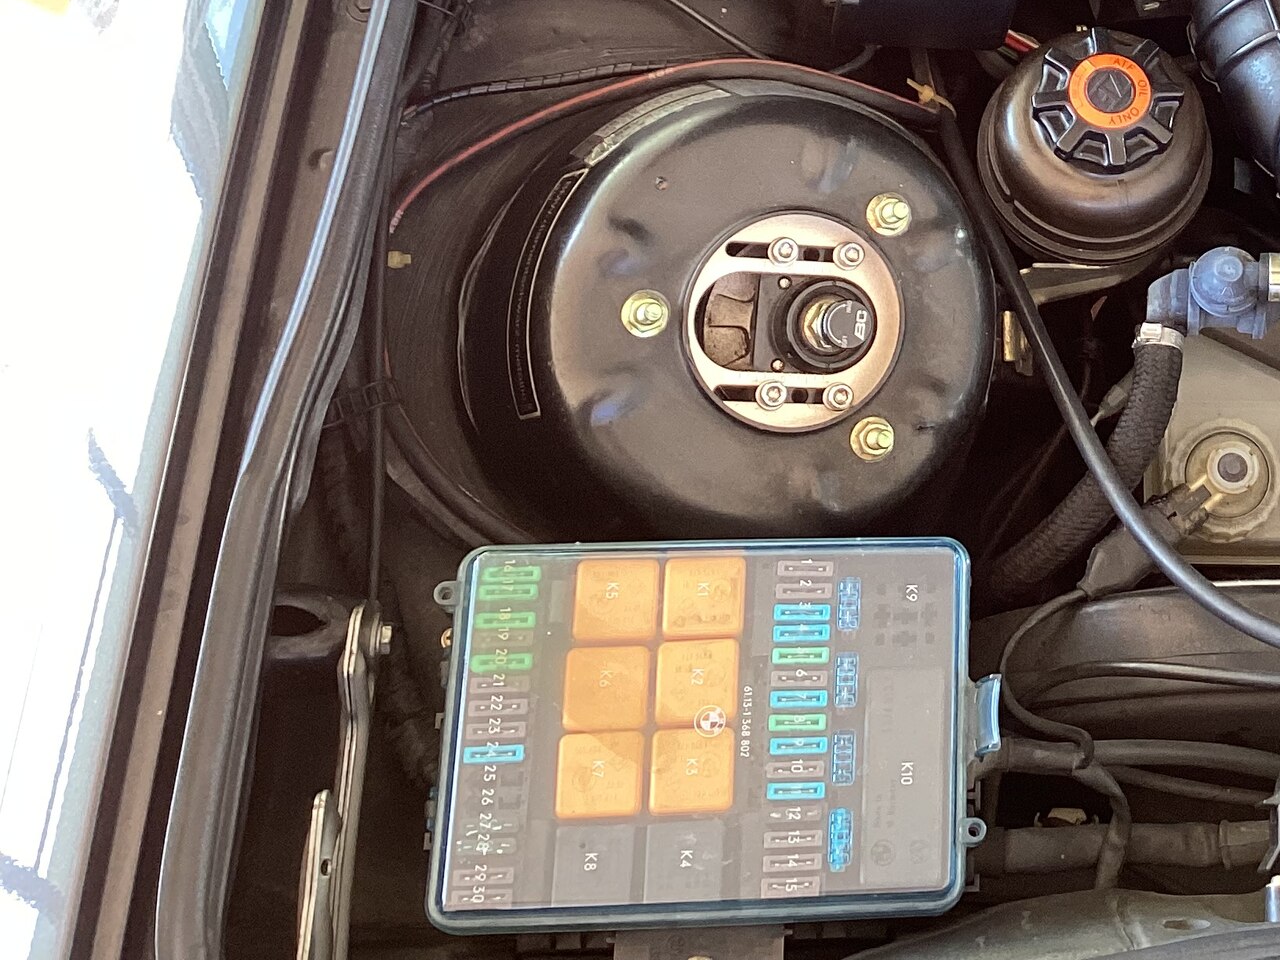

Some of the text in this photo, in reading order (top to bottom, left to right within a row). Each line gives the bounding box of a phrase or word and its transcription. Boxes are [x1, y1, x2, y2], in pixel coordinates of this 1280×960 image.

[1108, 57, 1150, 126] ATF OIL ONLY
[853, 309, 867, 340] BC
[740, 717, 751, 738] 368
[738, 739, 751, 758] 802
